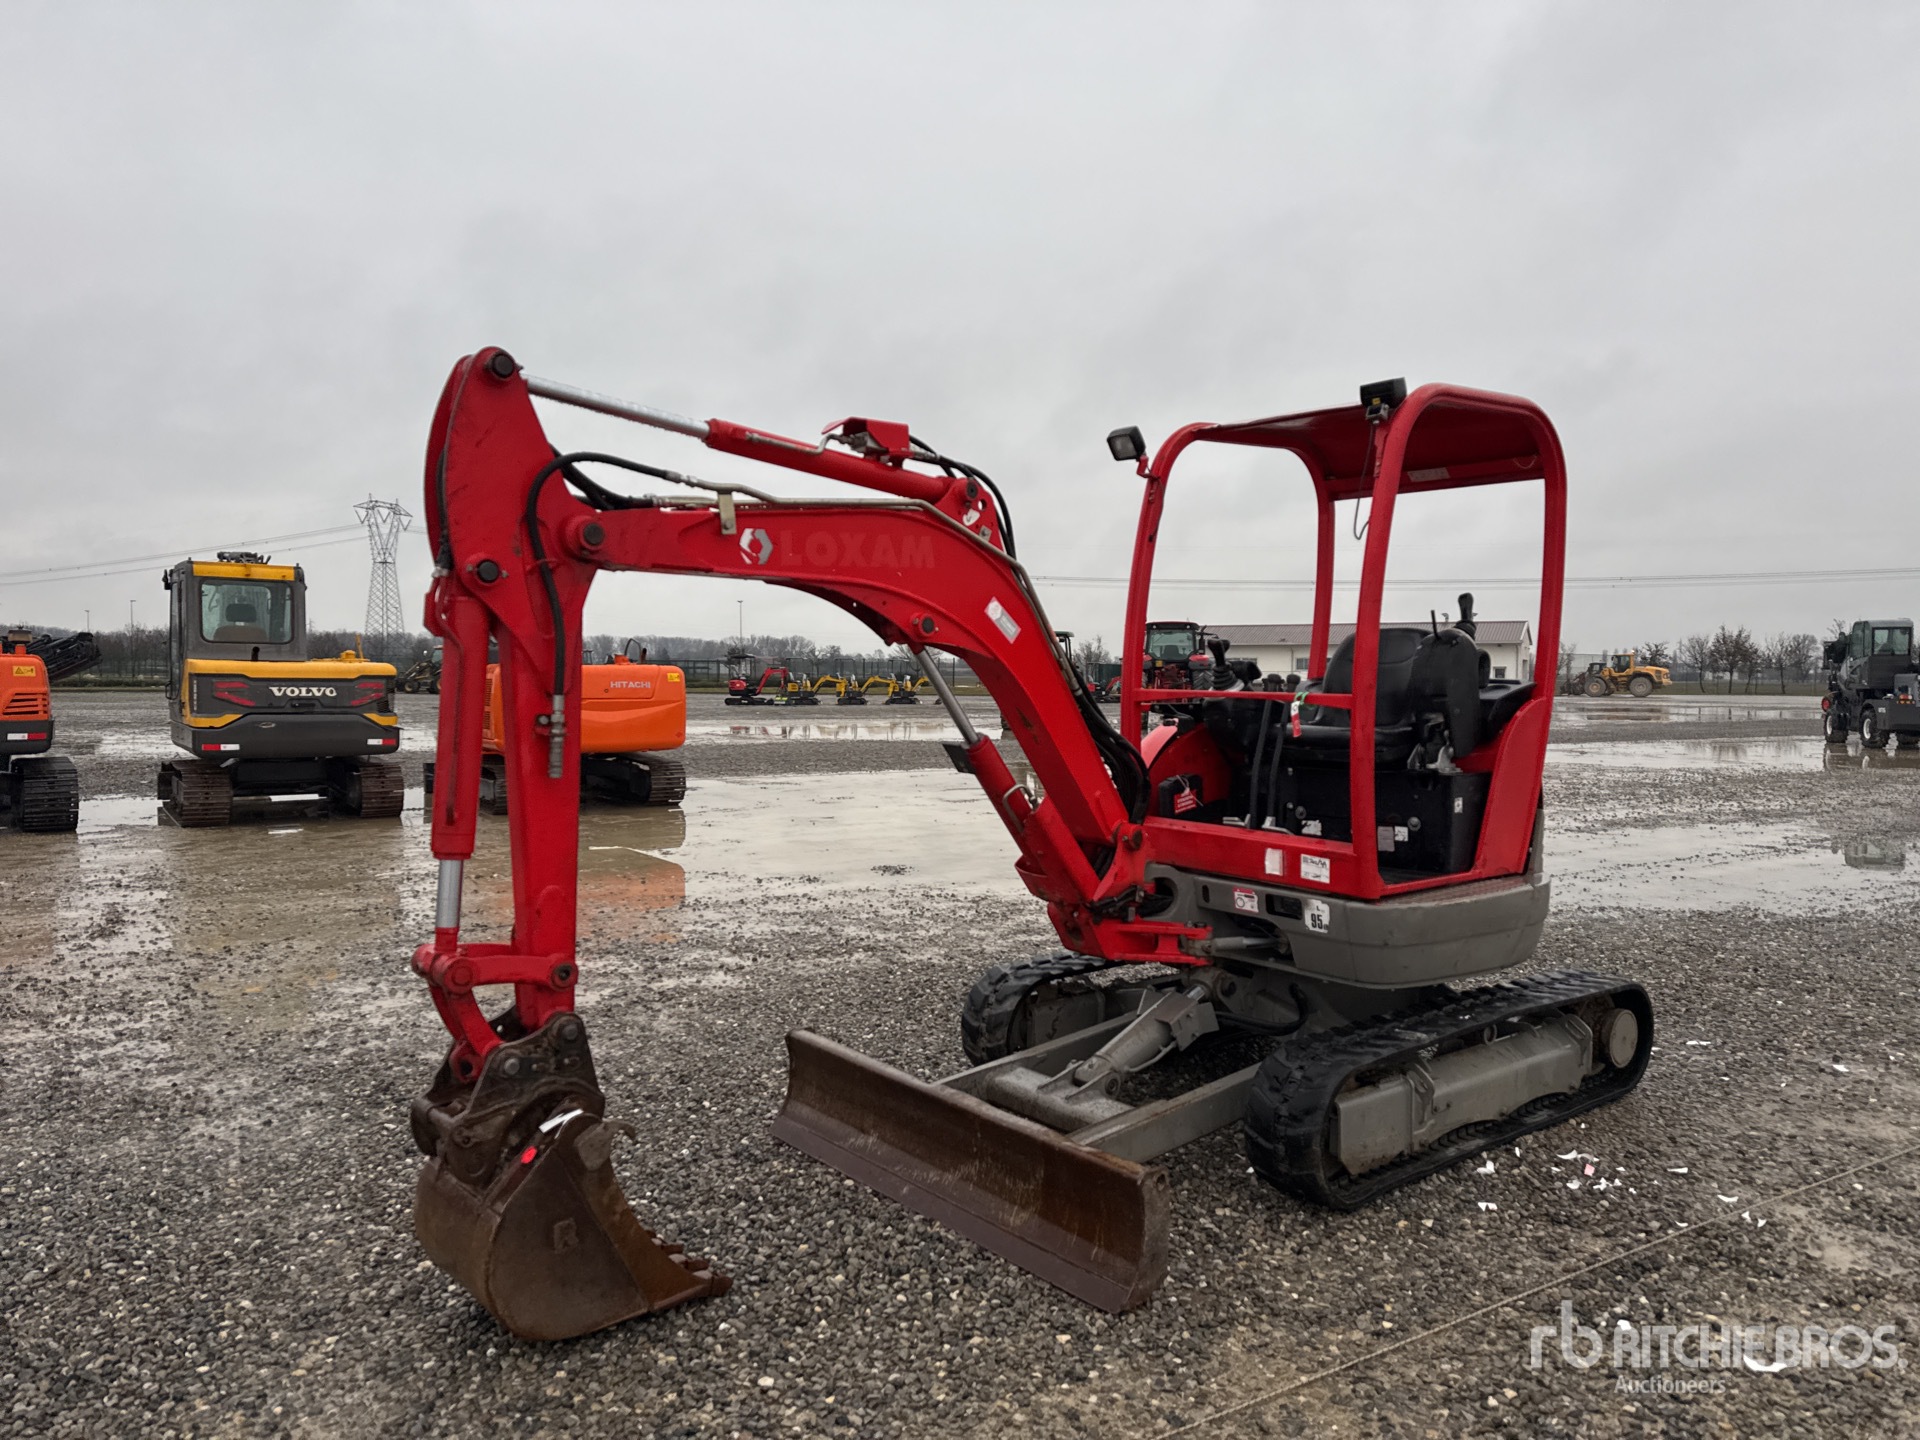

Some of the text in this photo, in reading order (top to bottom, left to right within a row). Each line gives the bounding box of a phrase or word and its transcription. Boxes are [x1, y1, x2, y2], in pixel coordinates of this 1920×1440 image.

[780, 530, 935, 568] LOXAM
[268, 686, 337, 697] VOLVO
[610, 681, 651, 689] HITACHI
[1311, 913, 1323, 929] 95
